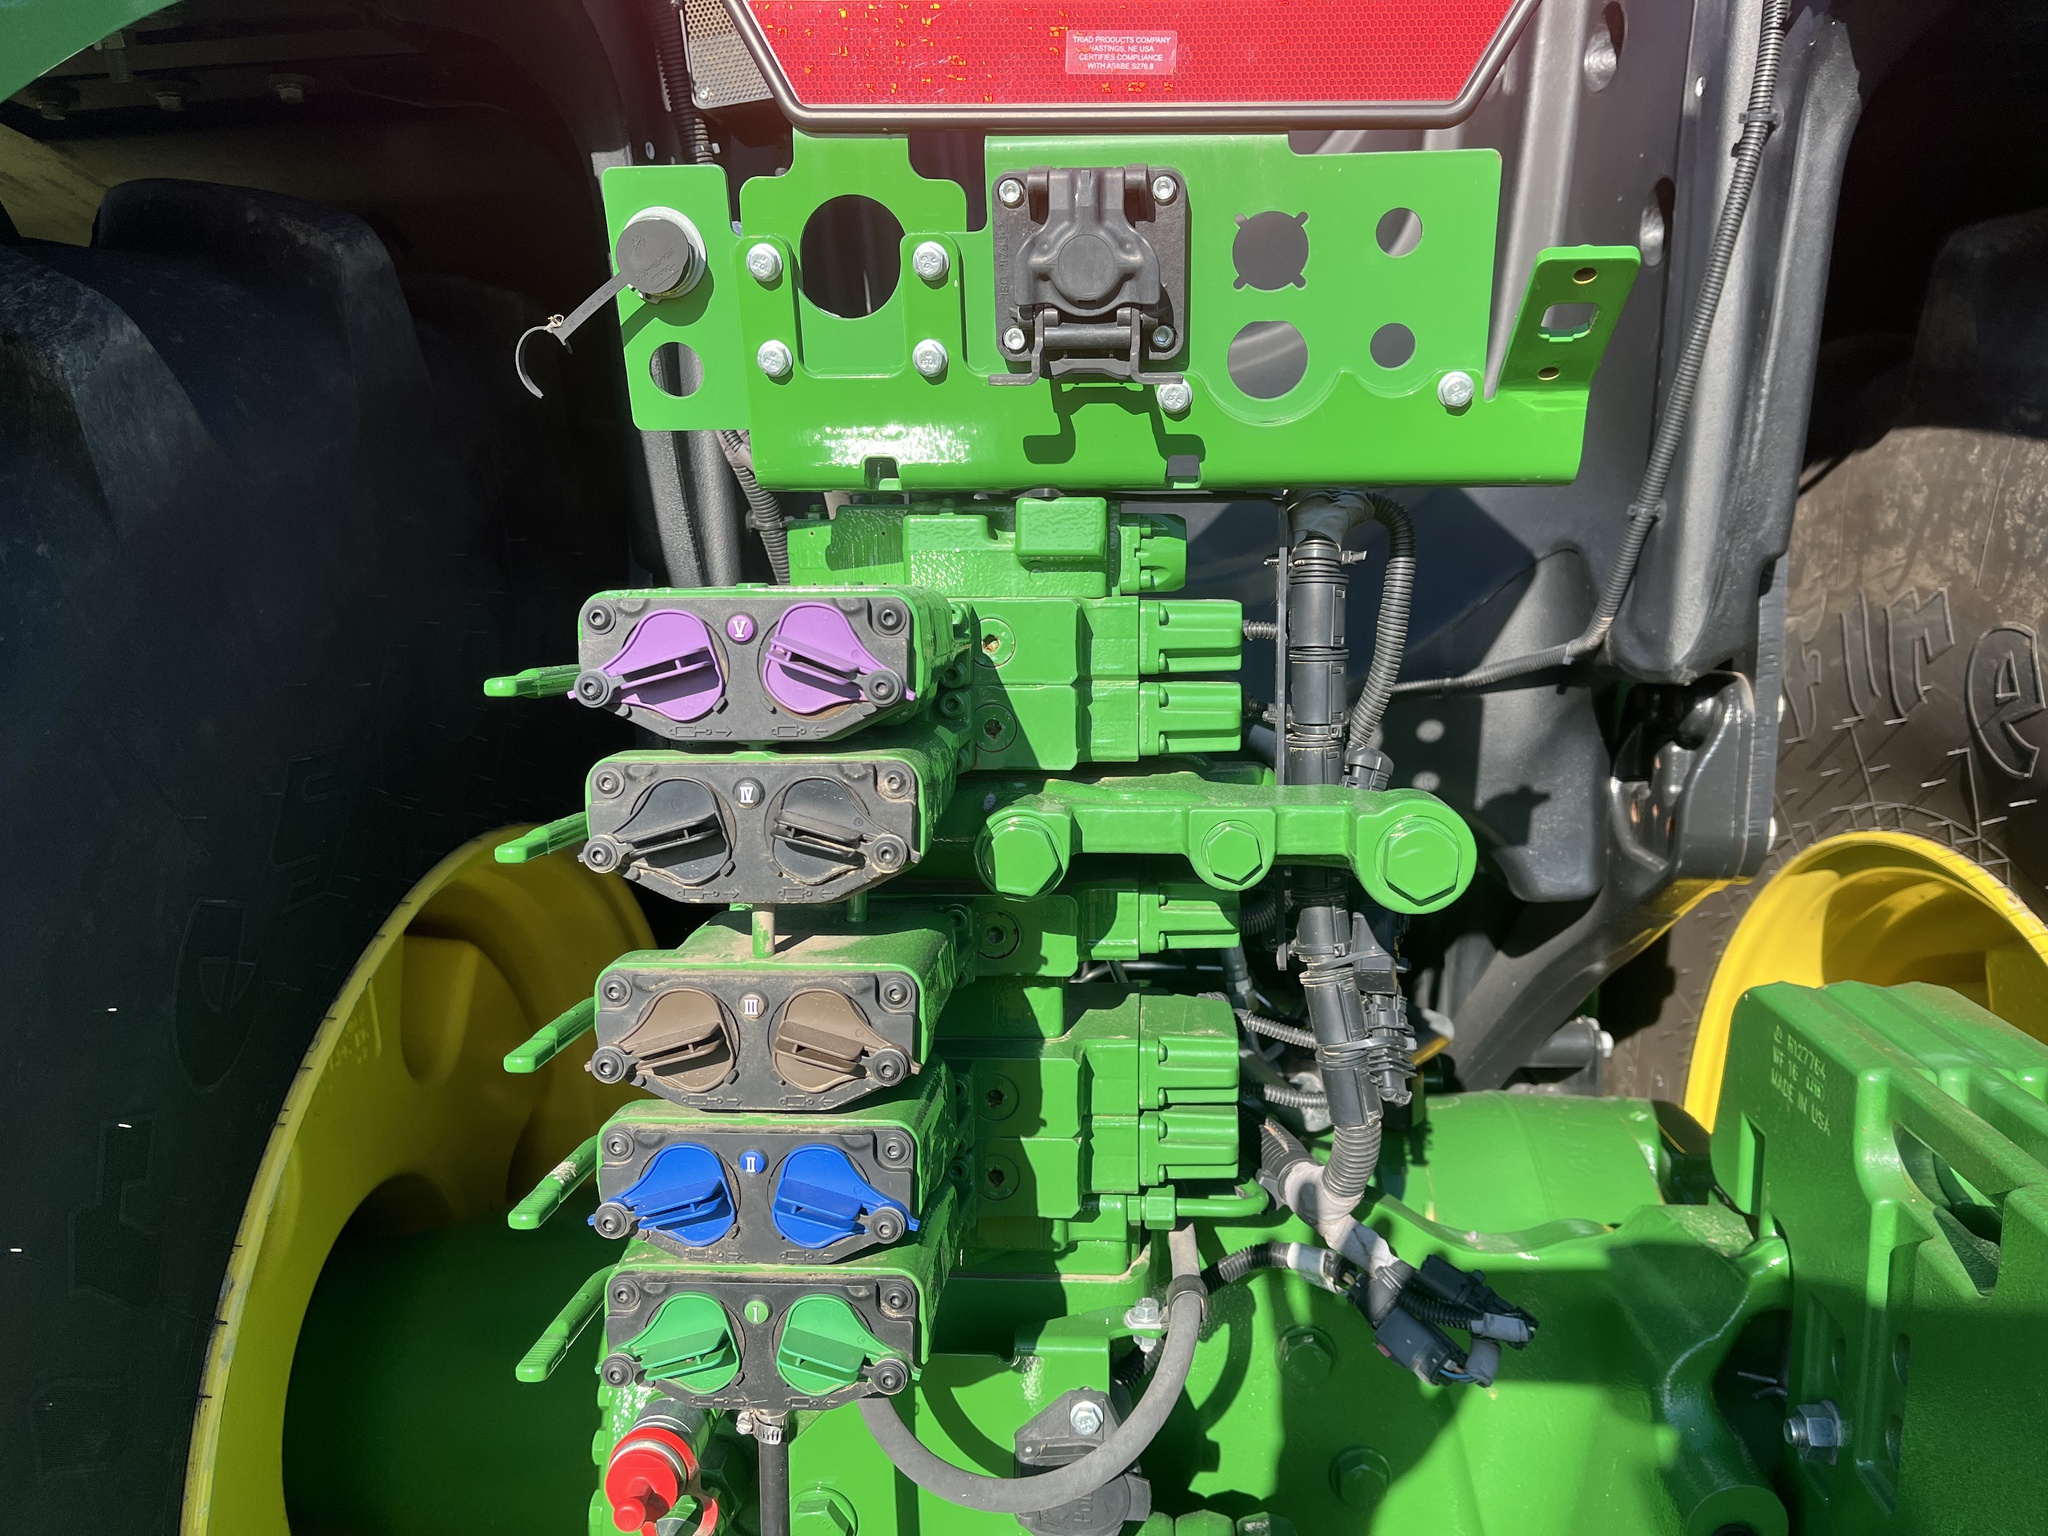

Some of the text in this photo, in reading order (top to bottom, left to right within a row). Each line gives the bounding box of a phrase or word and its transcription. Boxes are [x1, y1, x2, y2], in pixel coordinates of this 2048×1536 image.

[1072, 36, 1171, 44] TRIAD PRODUCTS COMPANY
[1128, 45, 1138, 53] NE
[1087, 62, 1106, 70] WITH
[1106, 62, 1130, 70] ASABE
[733, 620, 747, 638] V
[739, 786, 754, 804] IV
[744, 999, 759, 1015] III
[1771, 1068, 1795, 1103] MADE
[1797, 1091, 1808, 1114] IN
[1811, 1103, 1831, 1137] USA
[745, 1156, 757, 1173] II
